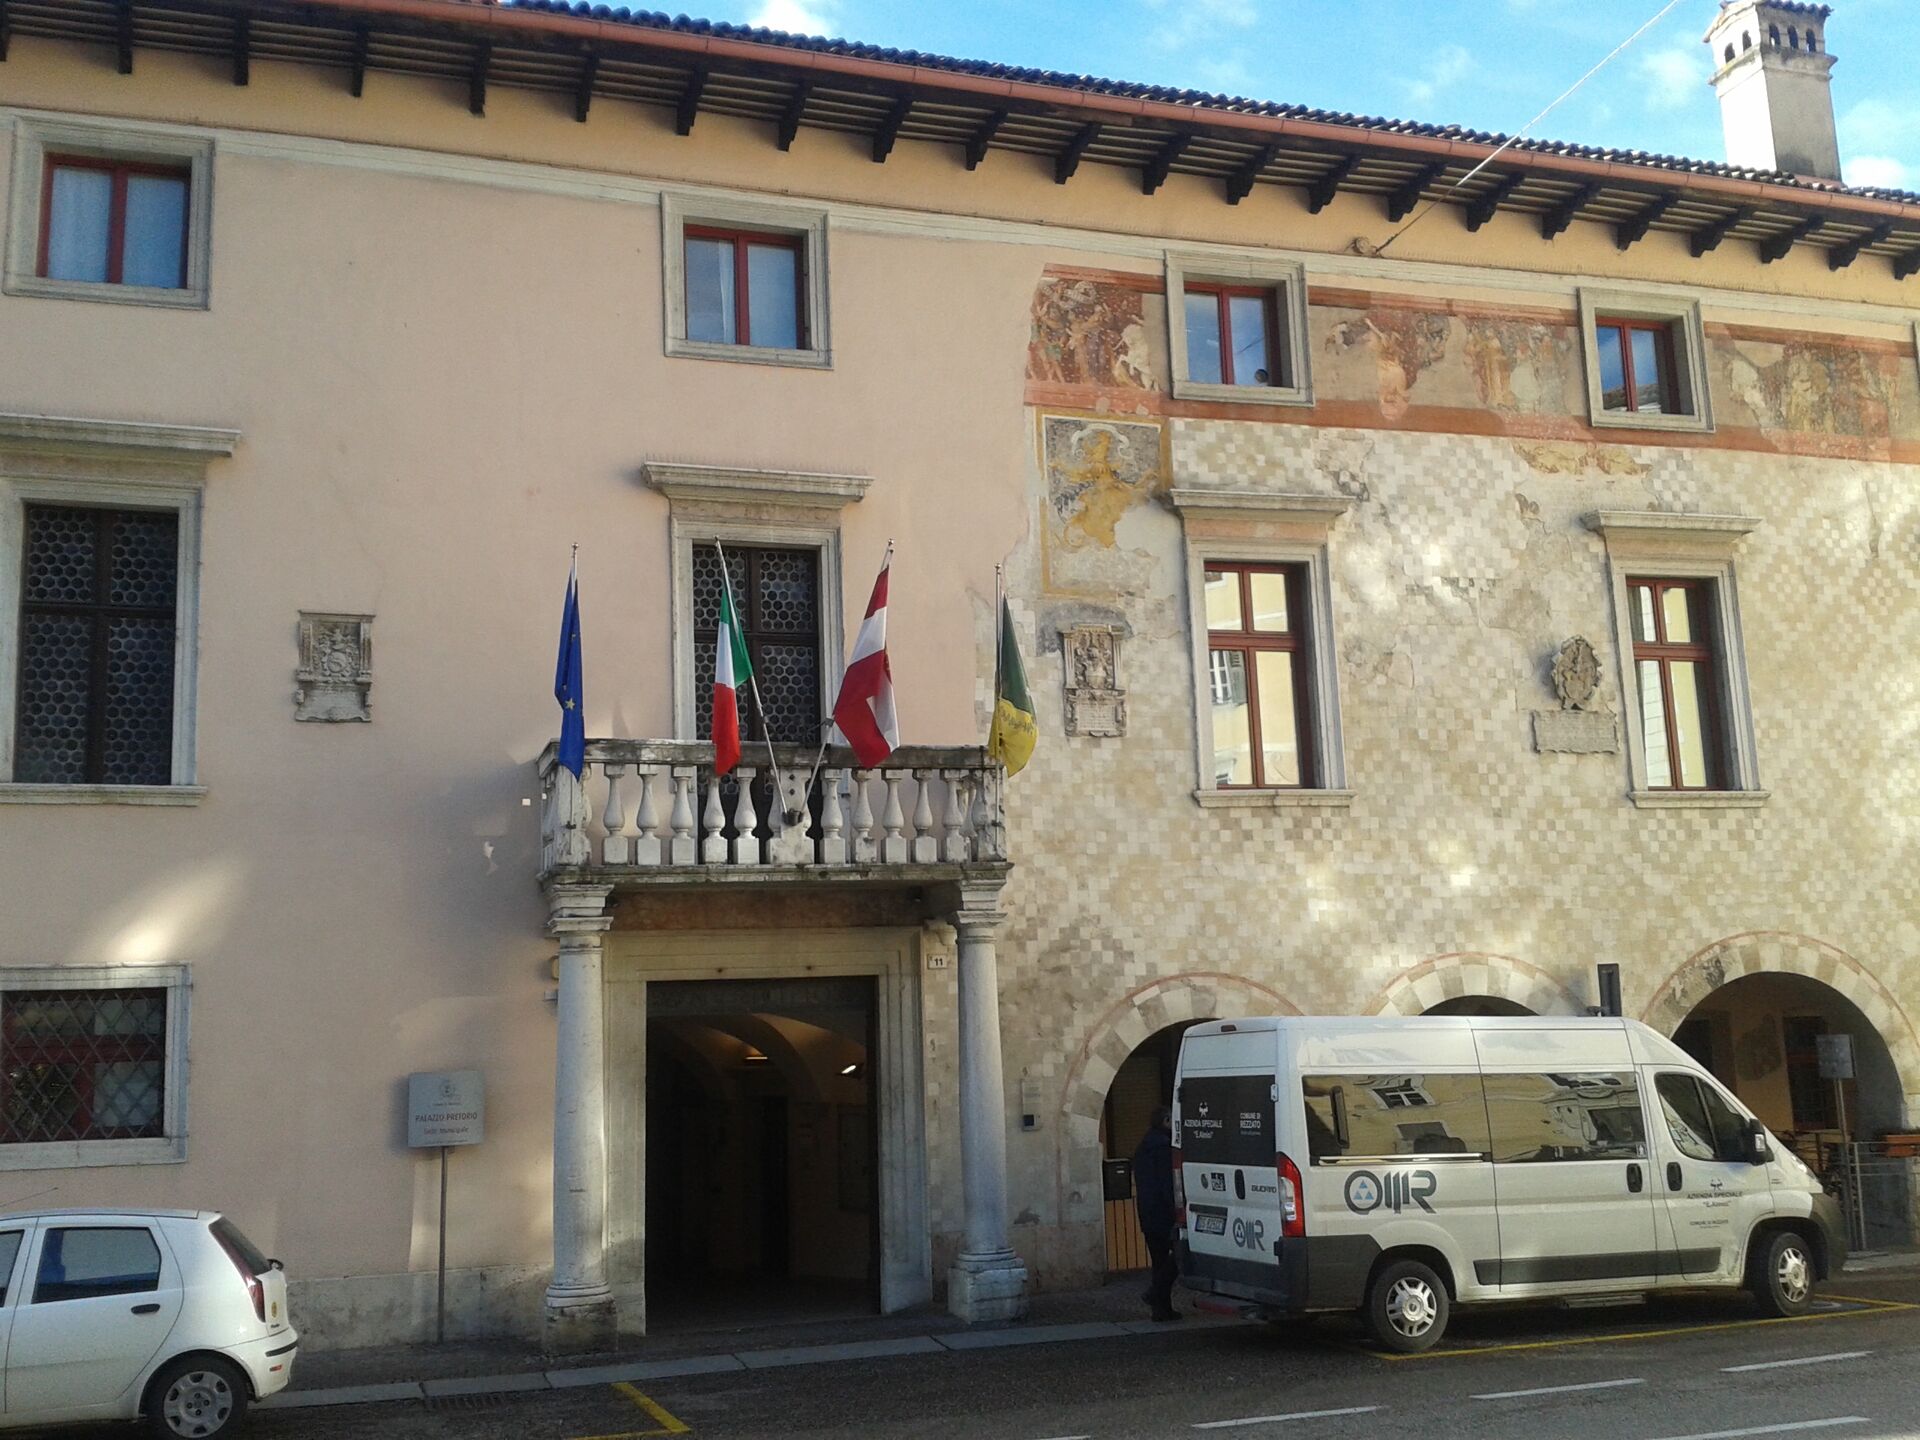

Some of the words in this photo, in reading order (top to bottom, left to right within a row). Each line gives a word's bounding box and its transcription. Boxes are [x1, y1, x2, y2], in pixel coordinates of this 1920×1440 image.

[934, 958, 943, 966] 11
[415, 1113, 445, 1122] PALAZZO
[446, 1112, 478, 1120] PRETORIO
[1184, 1119, 1201, 1128] AZIENDA
[1201, 1119, 1222, 1128] SPECIALE
